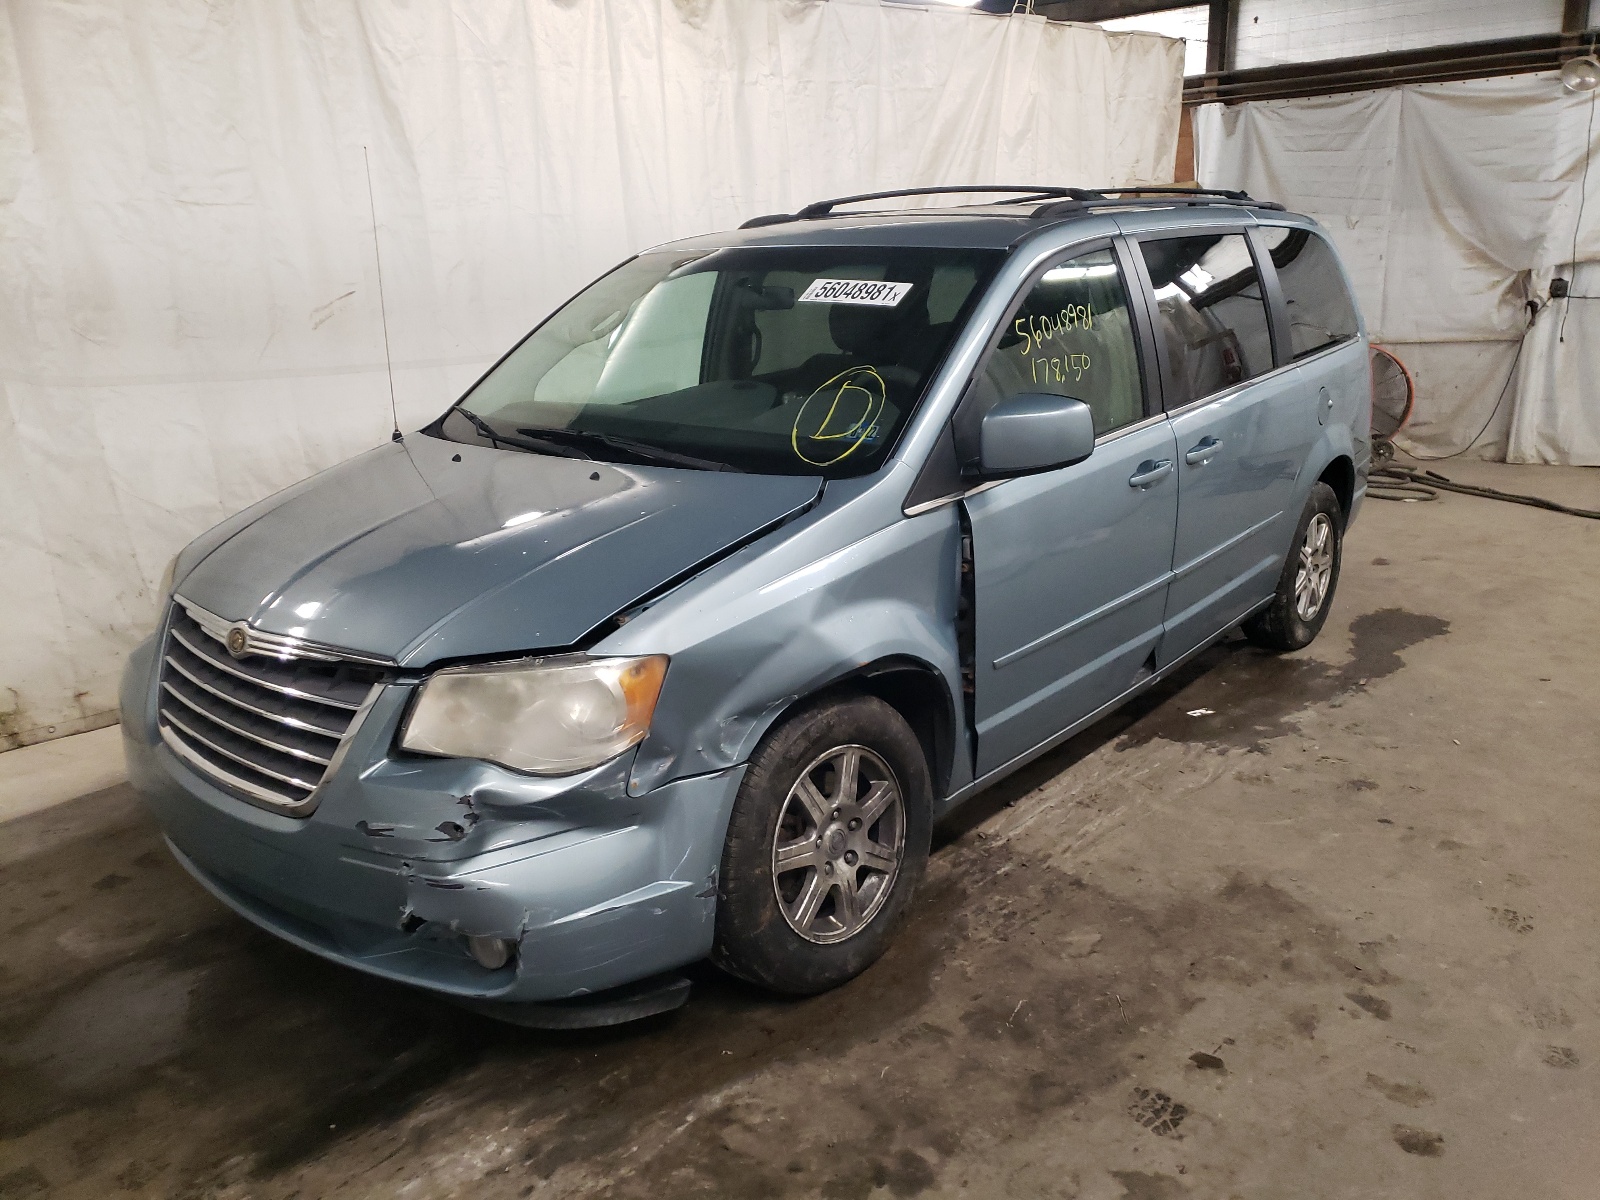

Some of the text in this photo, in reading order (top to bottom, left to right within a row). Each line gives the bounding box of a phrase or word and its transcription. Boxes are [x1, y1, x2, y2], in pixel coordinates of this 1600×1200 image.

[814, 281, 897, 301] 56048981
[1015, 302, 1093, 355] 56048981
[1031, 352, 1091, 385] 178,150
[808, 380, 873, 440] D
